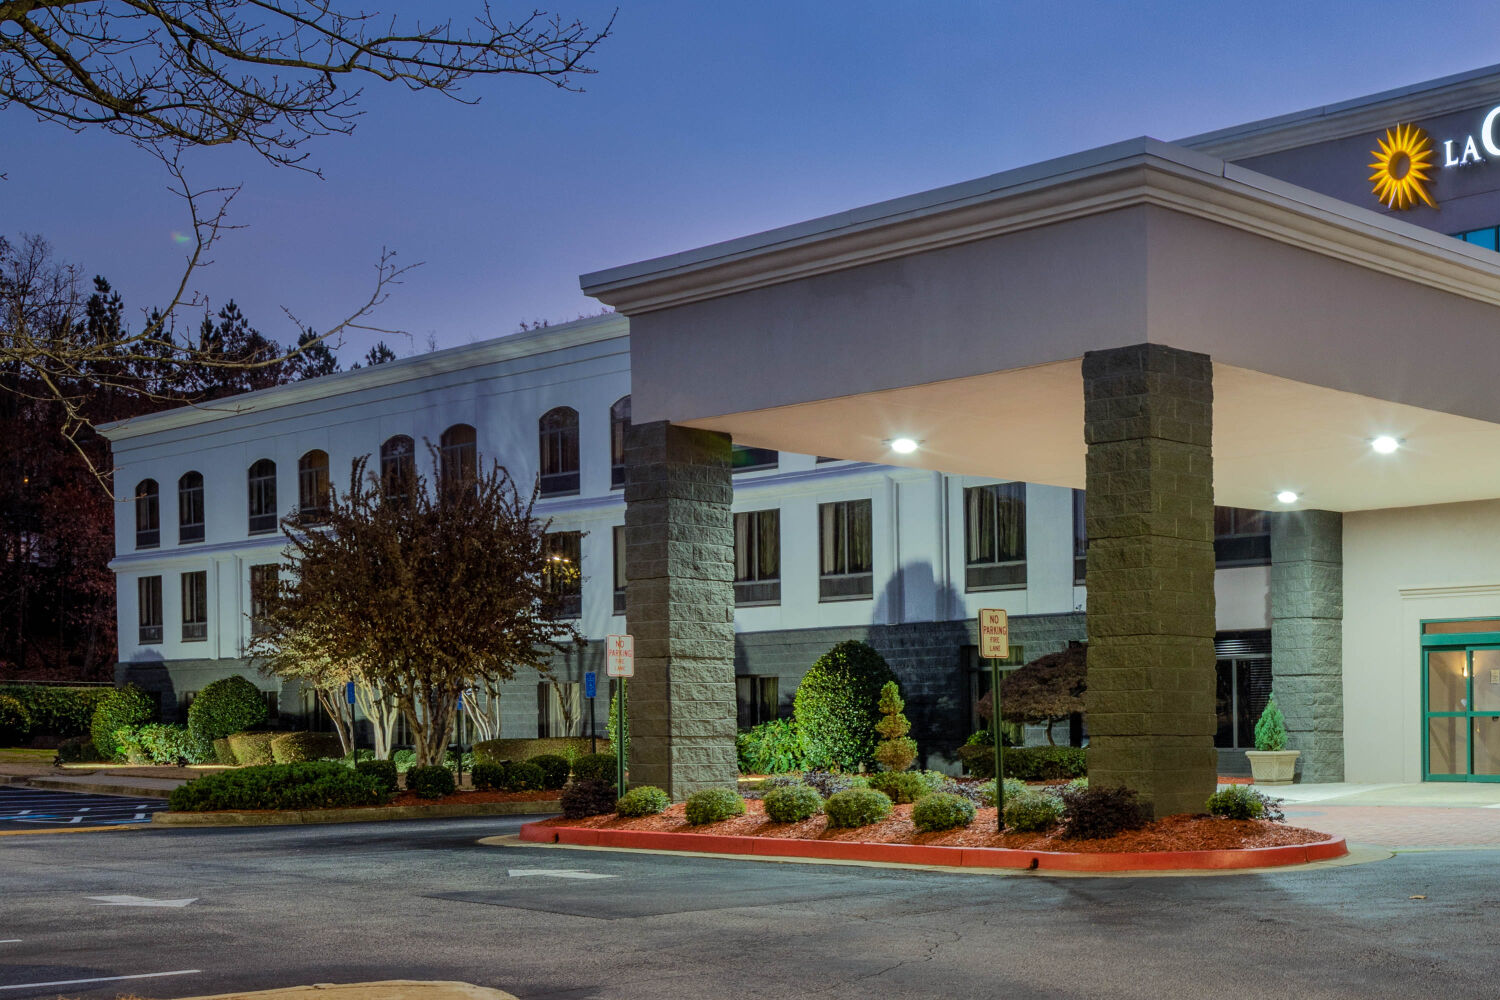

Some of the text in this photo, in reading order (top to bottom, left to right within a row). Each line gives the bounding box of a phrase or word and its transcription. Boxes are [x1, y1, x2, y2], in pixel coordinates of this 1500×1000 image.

[990, 615, 999, 624] NO
[983, 626, 1007, 635] PARKING
[615, 640, 625, 648] NO
[608, 649, 632, 657] PARKING
